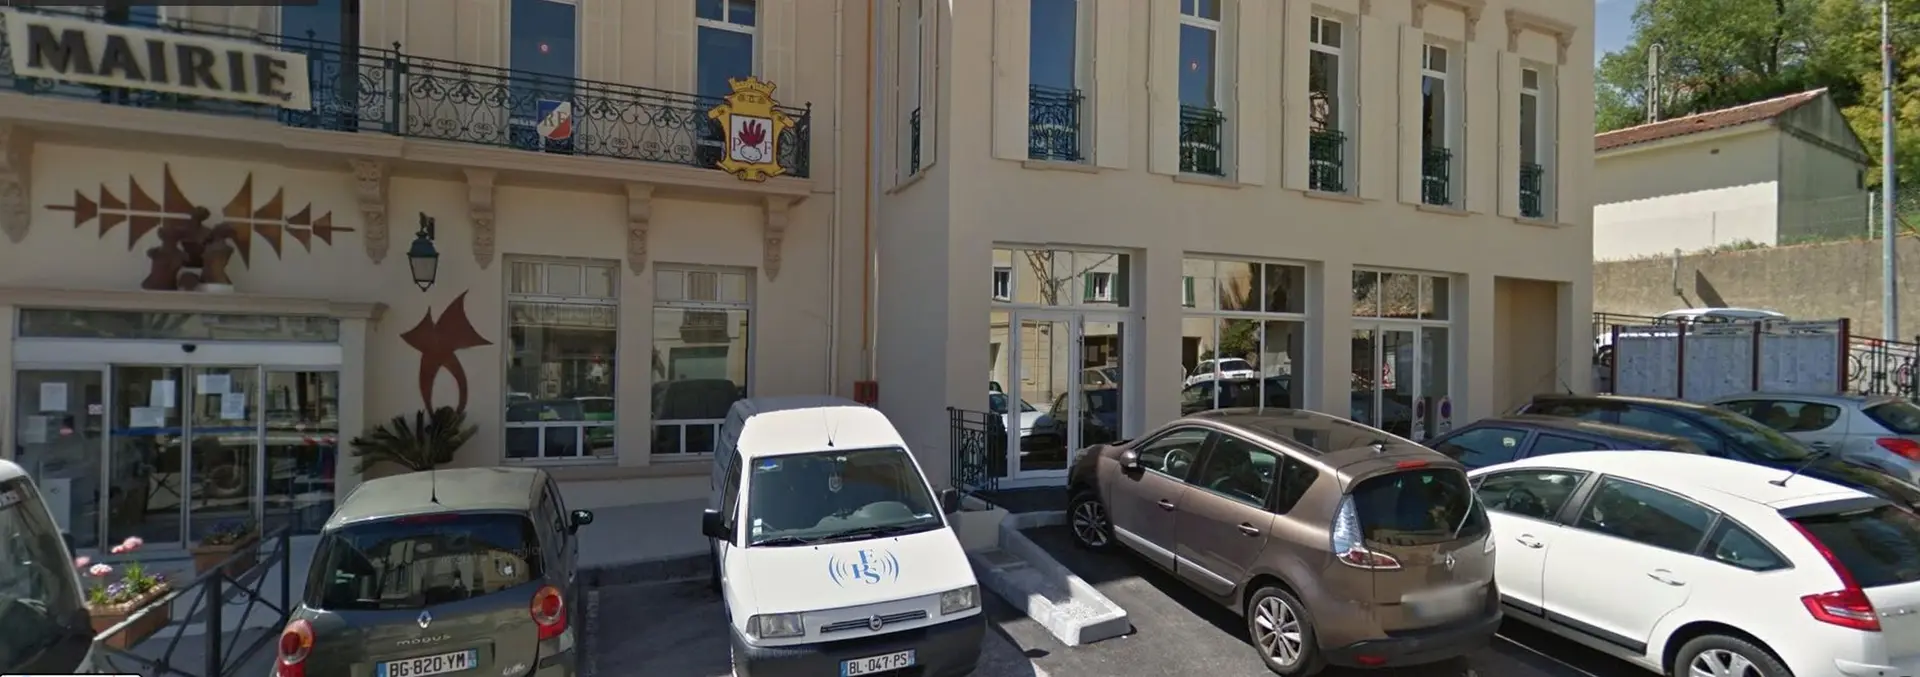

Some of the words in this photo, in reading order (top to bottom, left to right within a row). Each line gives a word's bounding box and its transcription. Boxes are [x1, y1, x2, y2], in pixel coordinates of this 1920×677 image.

[26, 23, 292, 101] MAIRIE
[543, 110, 568, 127] RF
[732, 136, 742, 152] P
